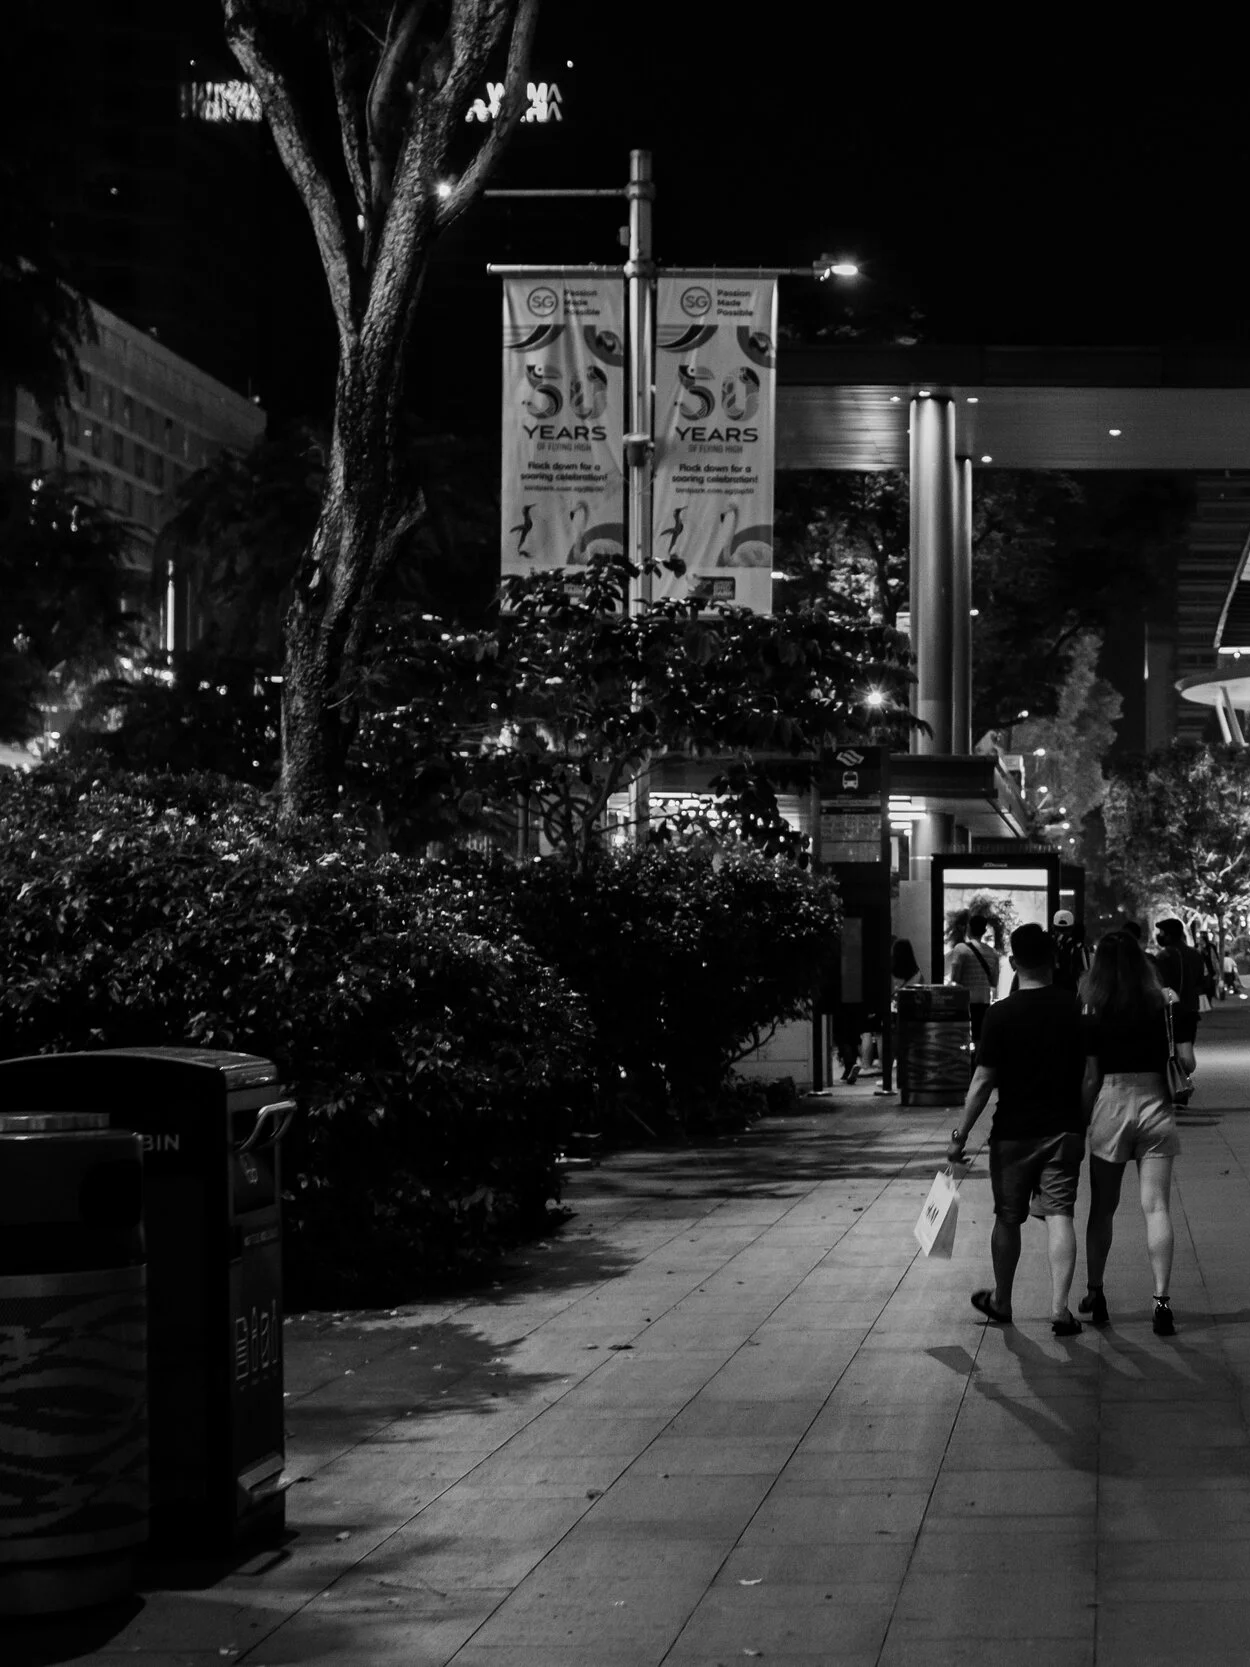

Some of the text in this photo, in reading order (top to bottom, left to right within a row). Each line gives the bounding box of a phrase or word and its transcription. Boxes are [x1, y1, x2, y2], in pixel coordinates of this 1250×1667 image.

[717, 289, 751, 297] Passion
[531, 295, 555, 309] SG
[685, 295, 708, 309] SG
[717, 308, 753, 316] Possible
[525, 364, 608, 420] 50
[676, 364, 760, 422] 50
[523, 424, 607, 441] YEARS
[675, 426, 758, 443] YEARS
[527, 461, 550, 470] Flock
[552, 462, 578, 471] down
[580, 462, 592, 471] for
[679, 463, 701, 473] Flock
[703, 464, 729, 473] down
[730, 464, 743, 473] for
[520, 473, 554, 482] soaring
[672, 475, 758, 484] soaring celebration!
[142, 1133, 180, 1152] BIN
